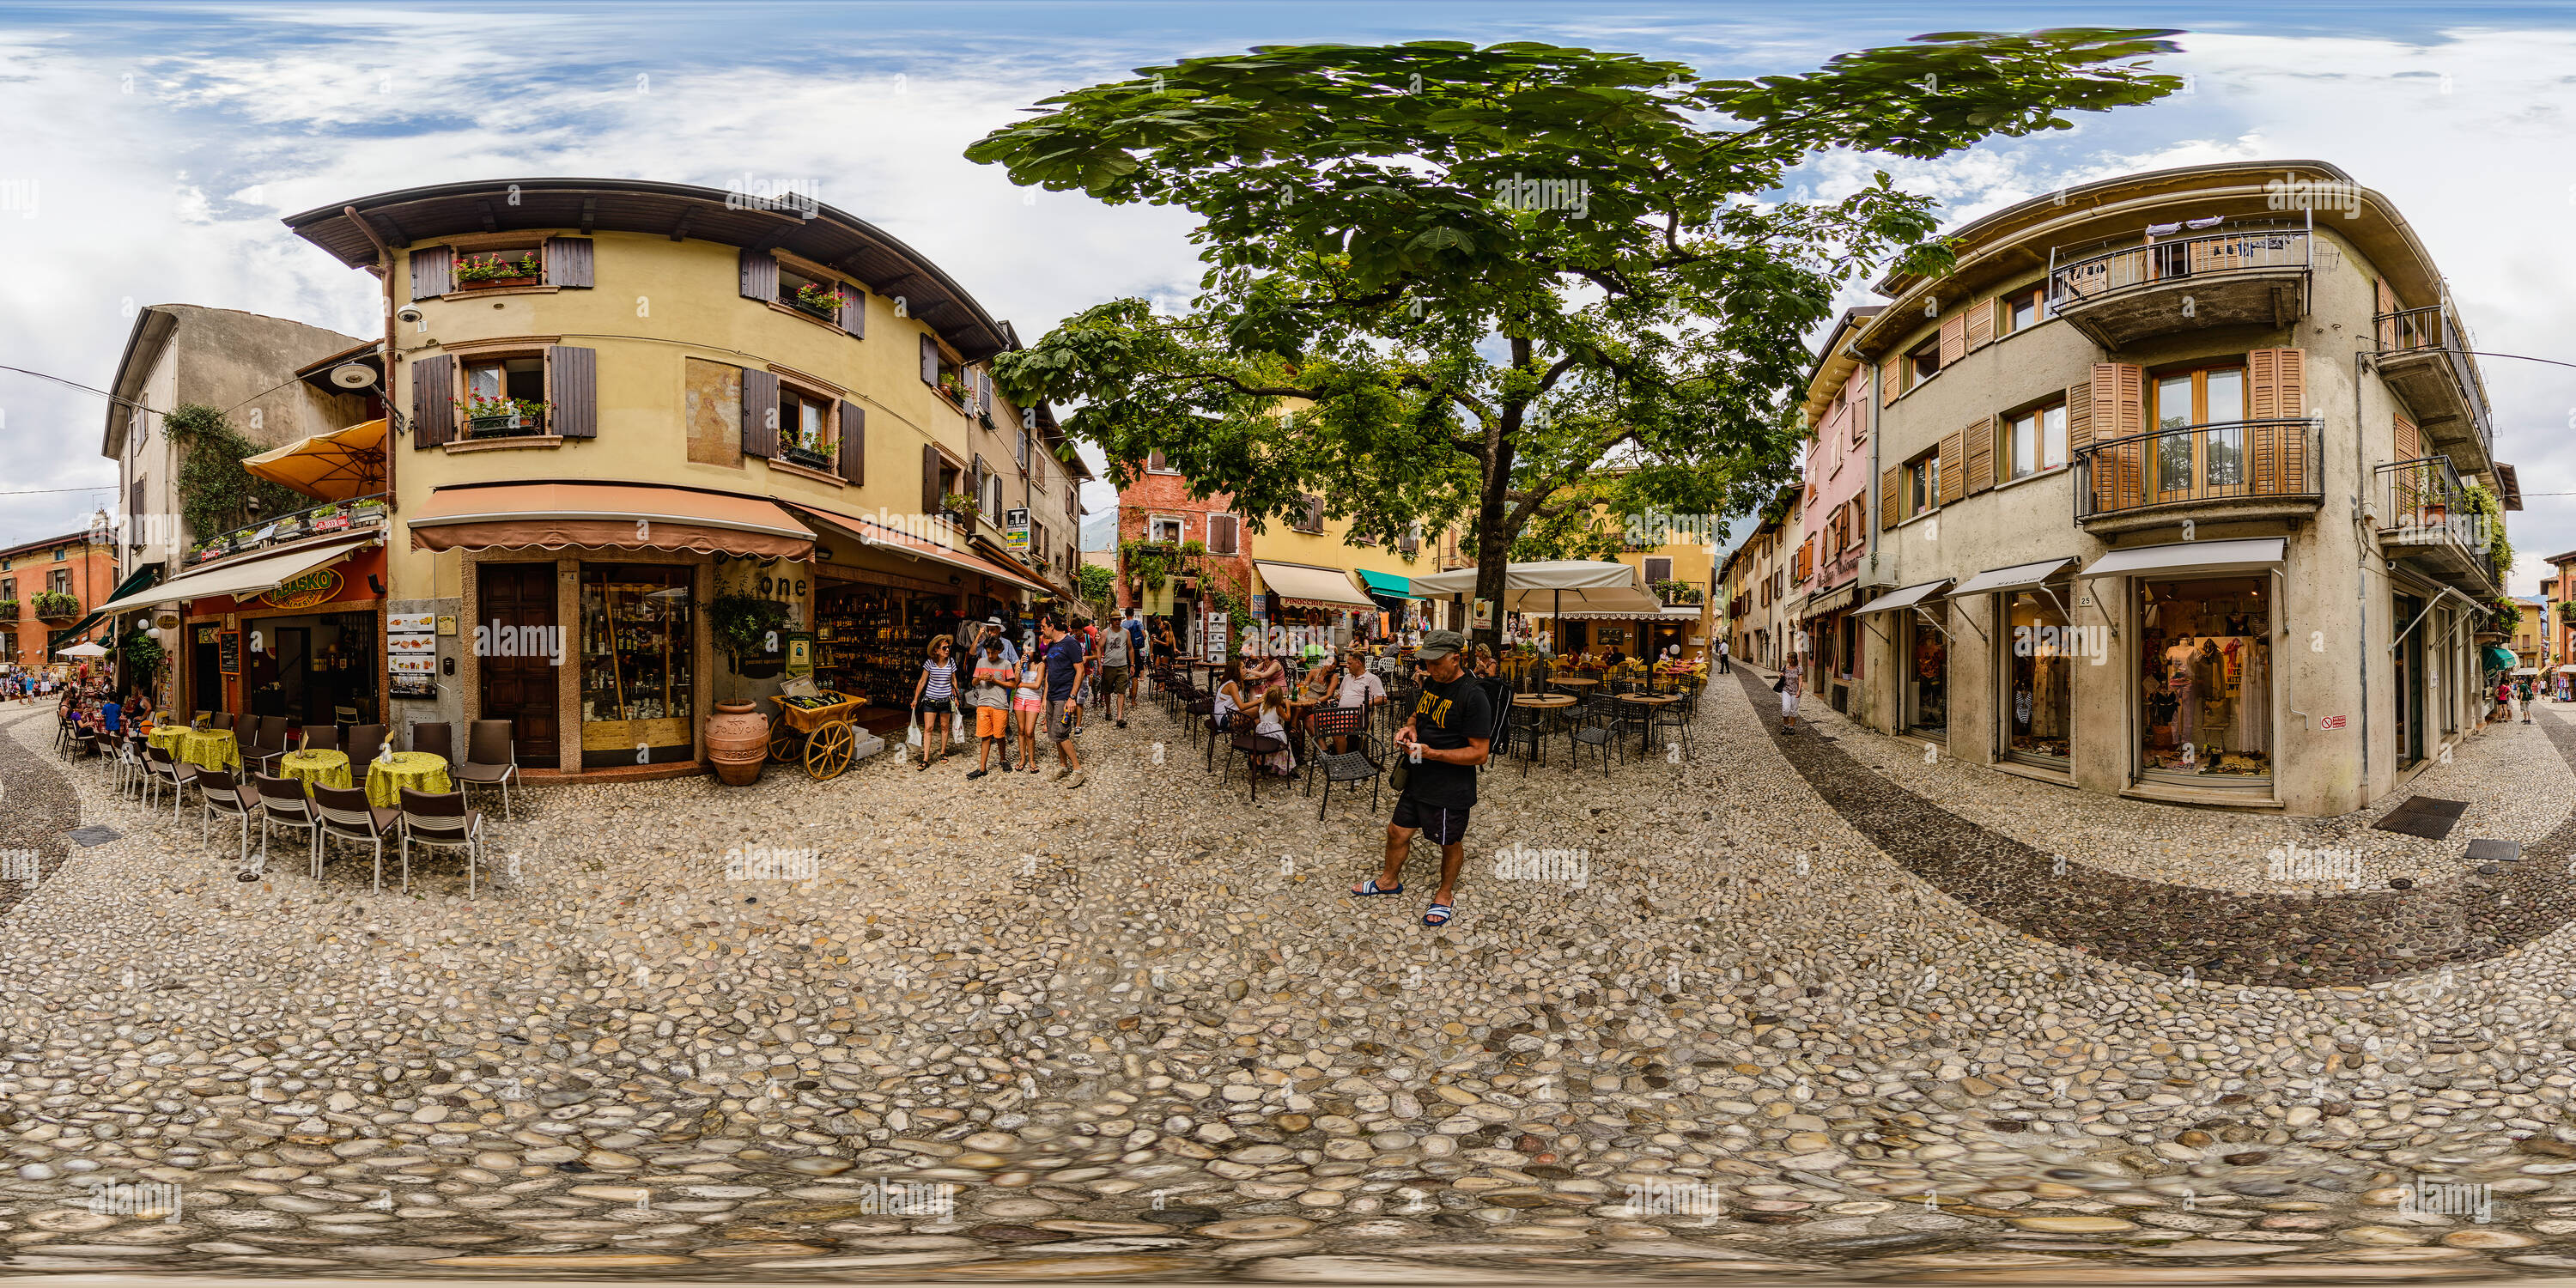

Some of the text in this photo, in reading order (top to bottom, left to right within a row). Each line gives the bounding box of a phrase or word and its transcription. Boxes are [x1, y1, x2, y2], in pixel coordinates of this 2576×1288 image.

[325, 519, 337, 529] BEER
[1011, 511, 1024, 524] T
[269, 570, 332, 603] TABASKO
[760, 577, 806, 597] one
[1285, 598, 1323, 606] PINOCCHIO
